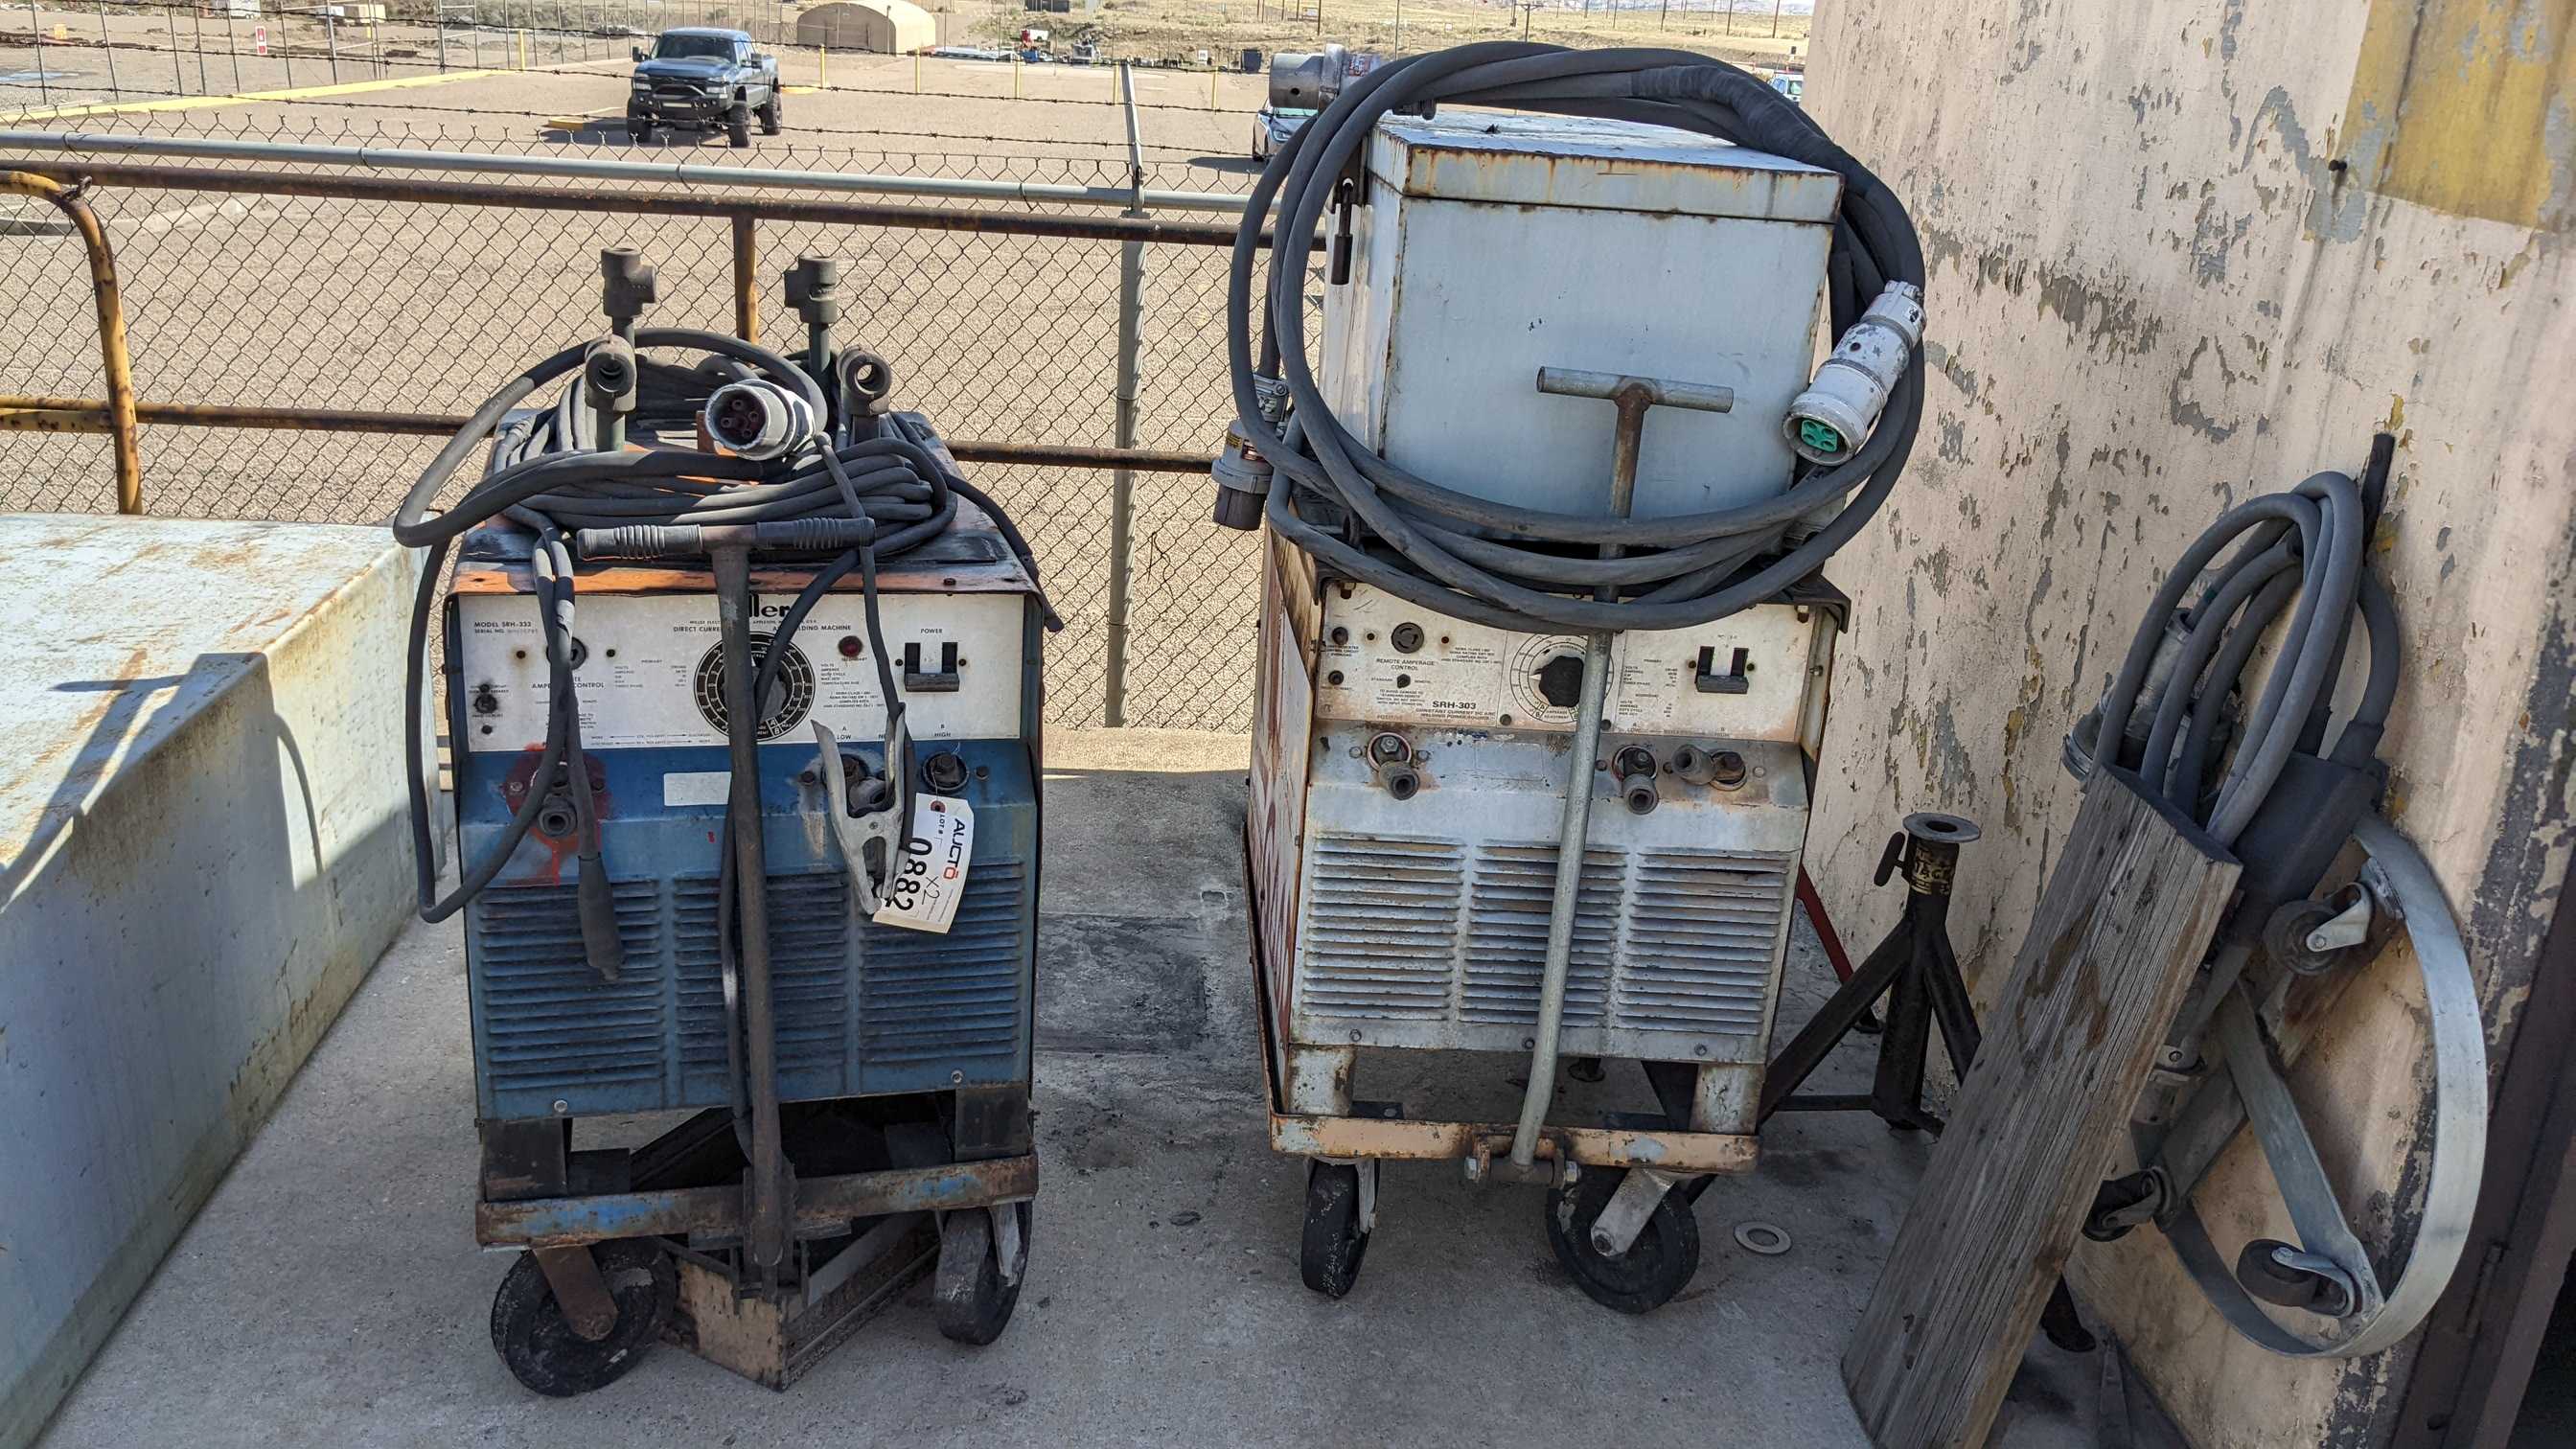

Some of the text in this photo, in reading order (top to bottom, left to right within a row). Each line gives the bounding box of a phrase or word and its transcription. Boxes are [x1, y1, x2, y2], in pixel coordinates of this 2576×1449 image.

[1432, 701, 1477, 710] SRH-303
[937, 815, 946, 829] LOT
[886, 837, 933, 911] 0882
